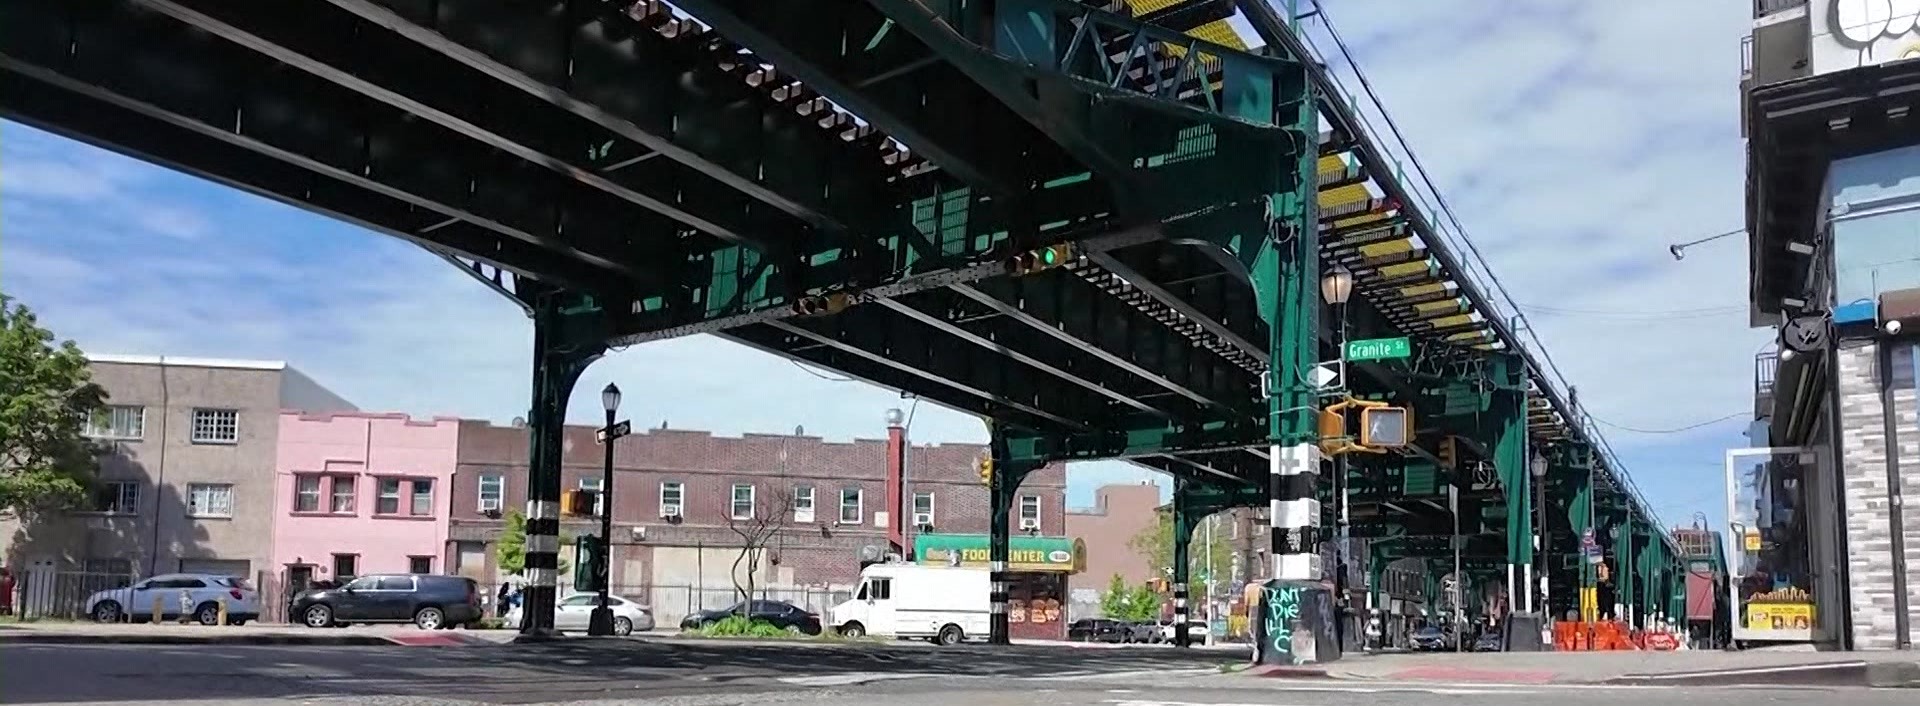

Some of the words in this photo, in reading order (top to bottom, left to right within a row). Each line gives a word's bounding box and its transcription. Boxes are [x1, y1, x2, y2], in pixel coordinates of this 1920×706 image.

[1349, 342, 1391, 358] Granite
[1395, 340, 1404, 349] St
[1008, 549, 1044, 562] ENTER
